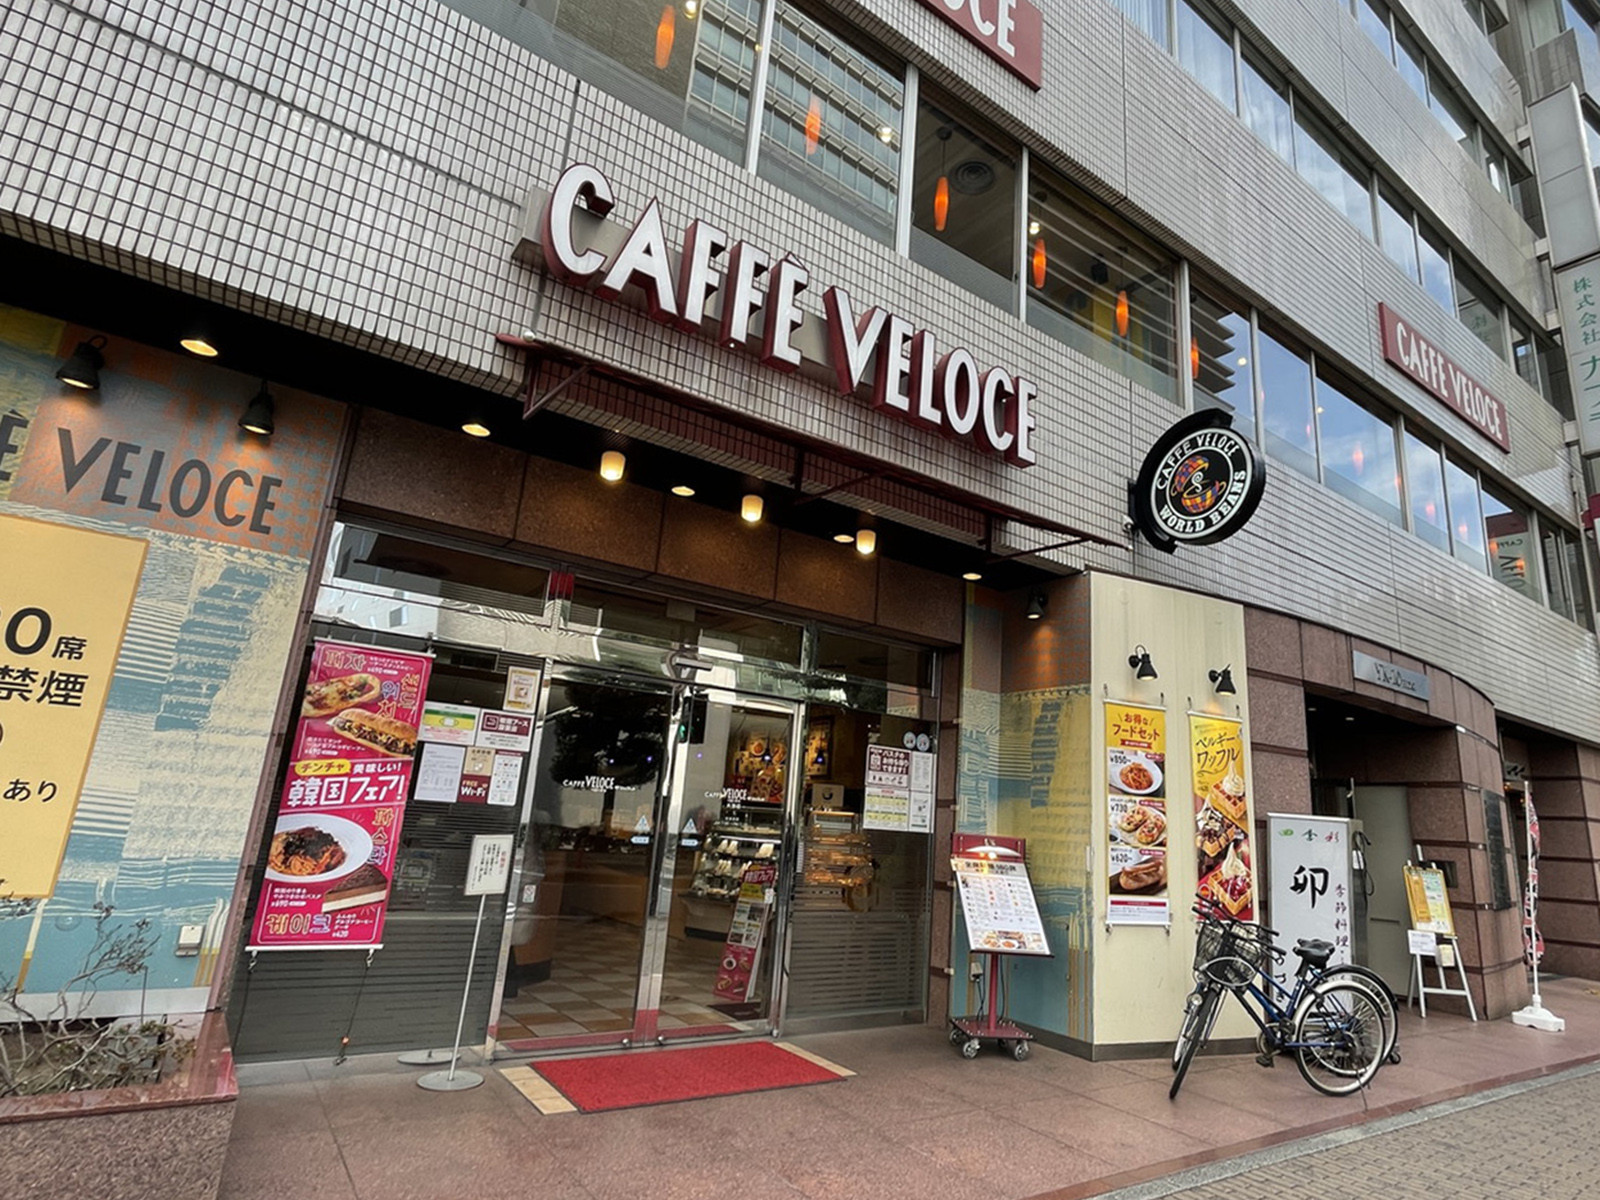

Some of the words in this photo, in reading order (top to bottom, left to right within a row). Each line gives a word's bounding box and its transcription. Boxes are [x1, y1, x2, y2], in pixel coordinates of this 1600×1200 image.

[942, 0, 1016, 57] CE
[824, 286, 1037, 468] VELOCE
[1448, 363, 1503, 441] VELOCE
[1196, 432, 1240, 457] VELOCE
[57, 427, 282, 535] VELOCE
[1159, 504, 1206, 533] WORLD
[1209, 470, 1247, 525] BEANS
[1124, 712, 1149, 725] お得な
[1112, 723, 1161, 741] フードセット
[1195, 732, 1236, 748] ベルギー
[301, 761, 345, 773] チンチャ
[1196, 747, 1240, 773] ワッフル
[3, 778, 59, 803] あり
[288, 775, 406, 807] 韓国フェア!
[460, 787, 487, 797] Wi-Fi
[585, 775, 615, 790] VELOCE
[265, 913, 332, 935] 케이크
